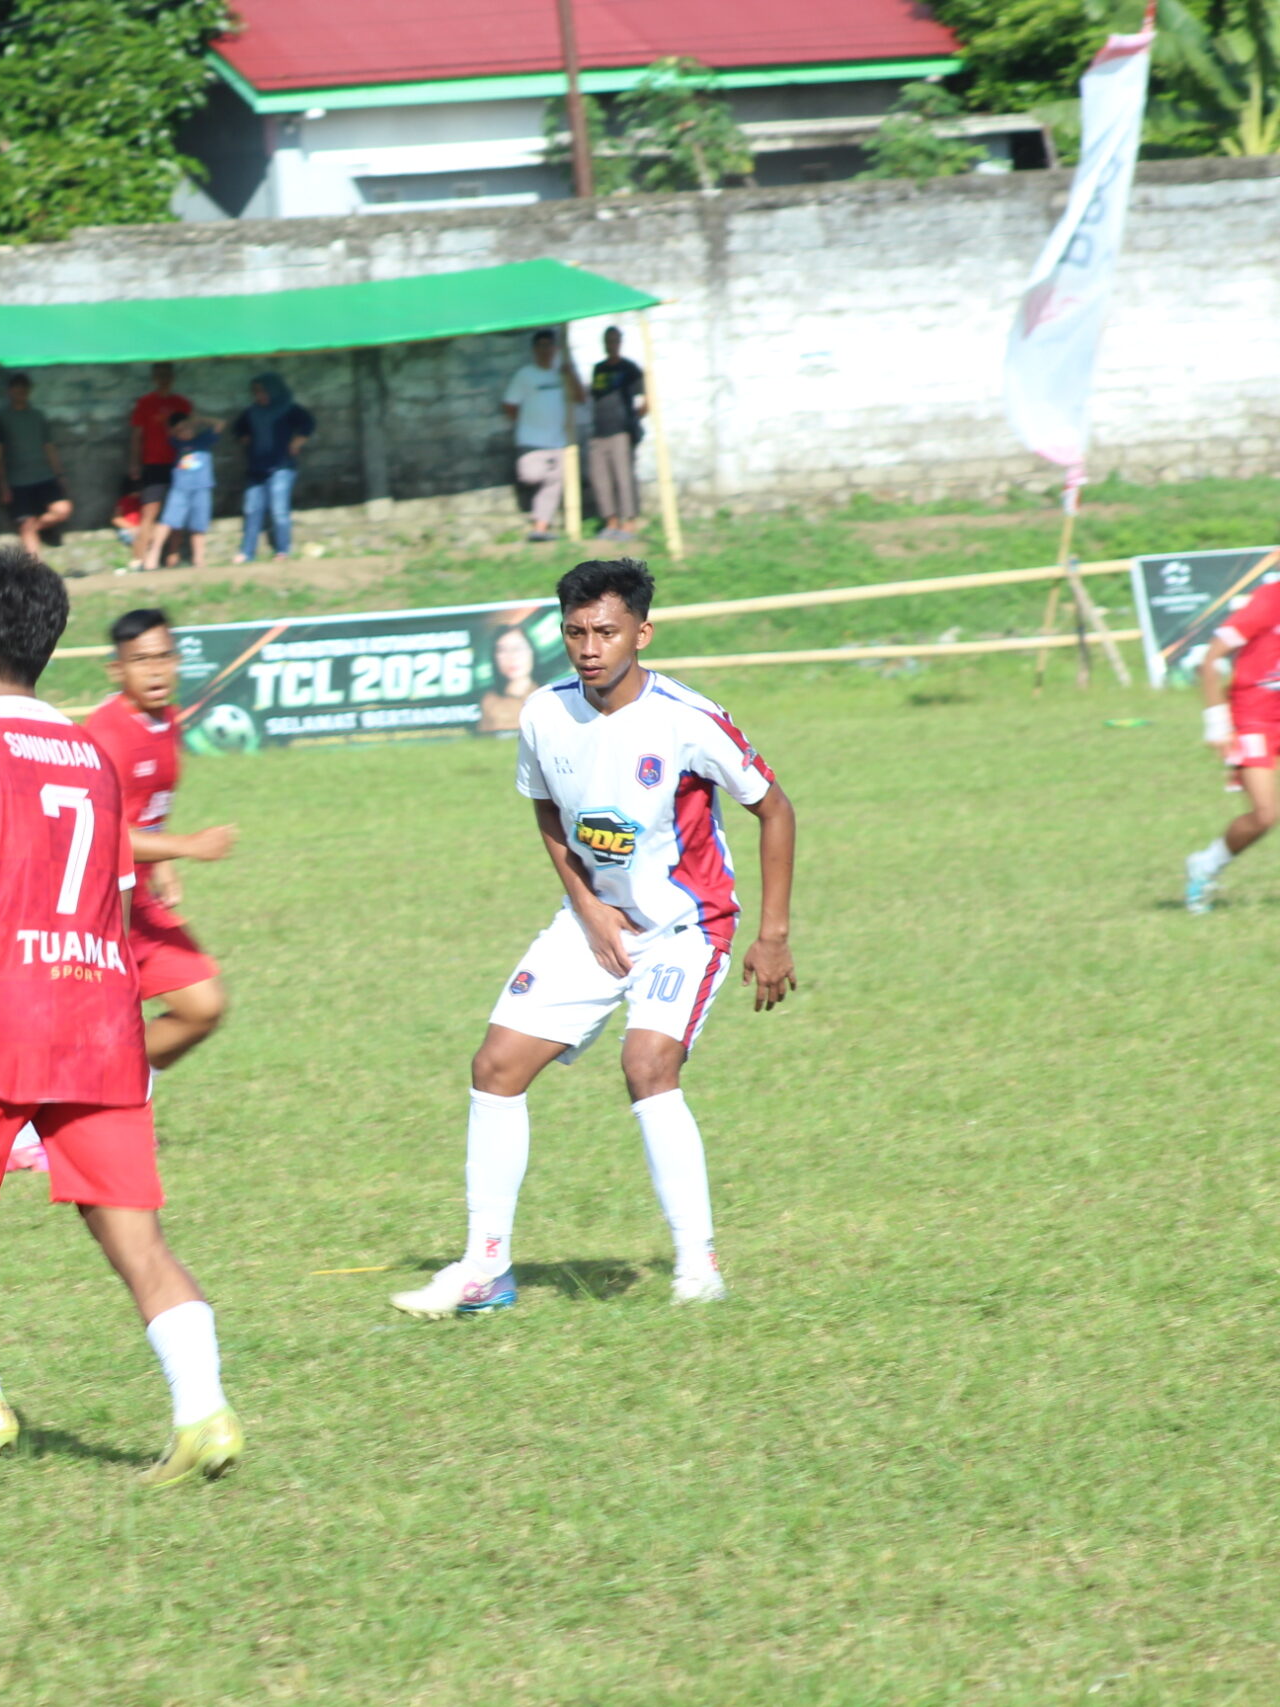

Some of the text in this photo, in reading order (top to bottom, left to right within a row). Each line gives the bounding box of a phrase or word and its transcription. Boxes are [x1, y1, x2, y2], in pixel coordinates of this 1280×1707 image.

[248, 648, 474, 711] TCL 2026
[39, 783, 94, 915] 7
[17, 929, 127, 975] TUAMA
[50, 964, 103, 983] SPORT
[646, 963, 686, 1003] 10
